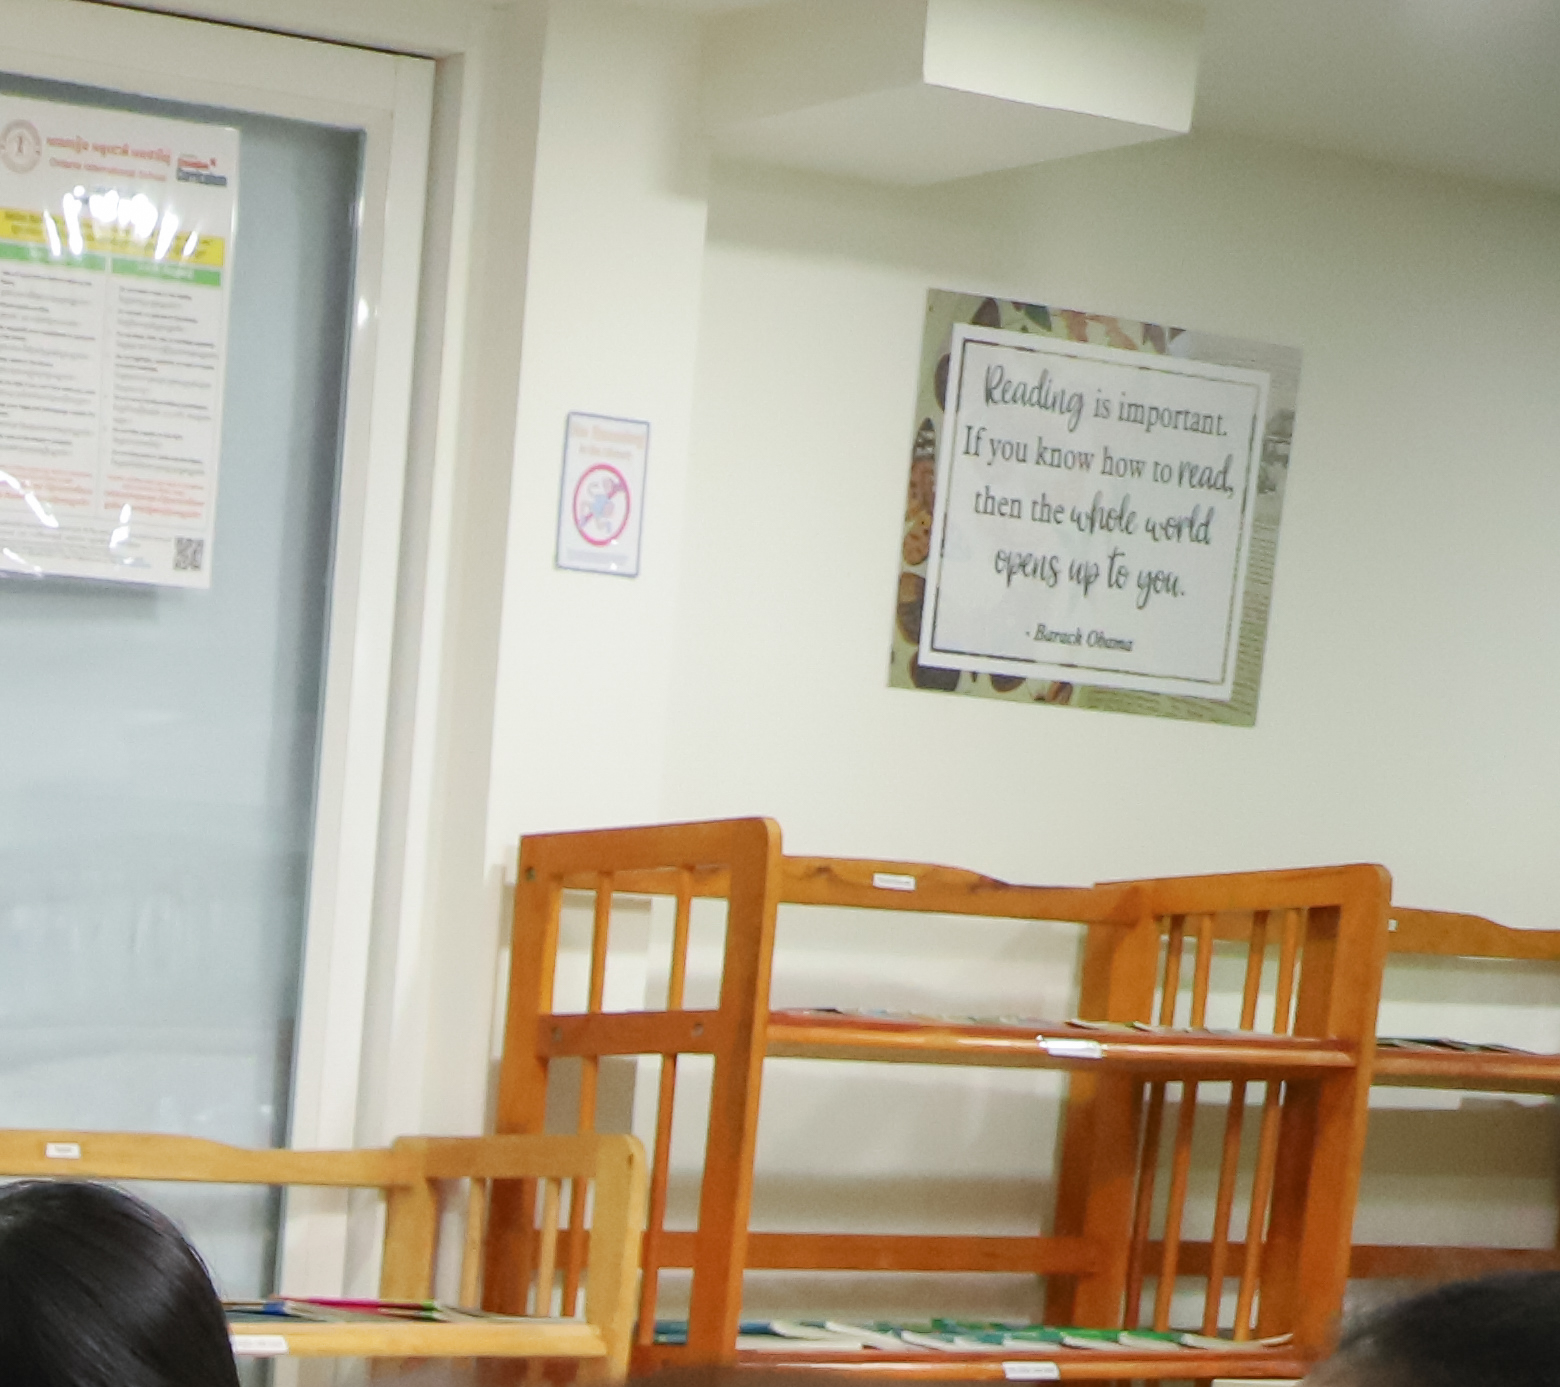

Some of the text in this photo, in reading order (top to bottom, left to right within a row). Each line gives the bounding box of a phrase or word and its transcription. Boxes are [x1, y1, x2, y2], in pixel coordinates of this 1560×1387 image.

[984, 365, 1228, 437] Reading is important.
[962, 425, 1235, 499] If you know how to read,
[974, 485, 1215, 546] then the whole world
[994, 546, 1186, 610] opens up to you.
[1033, 624, 1134, 653] Barack Obama
